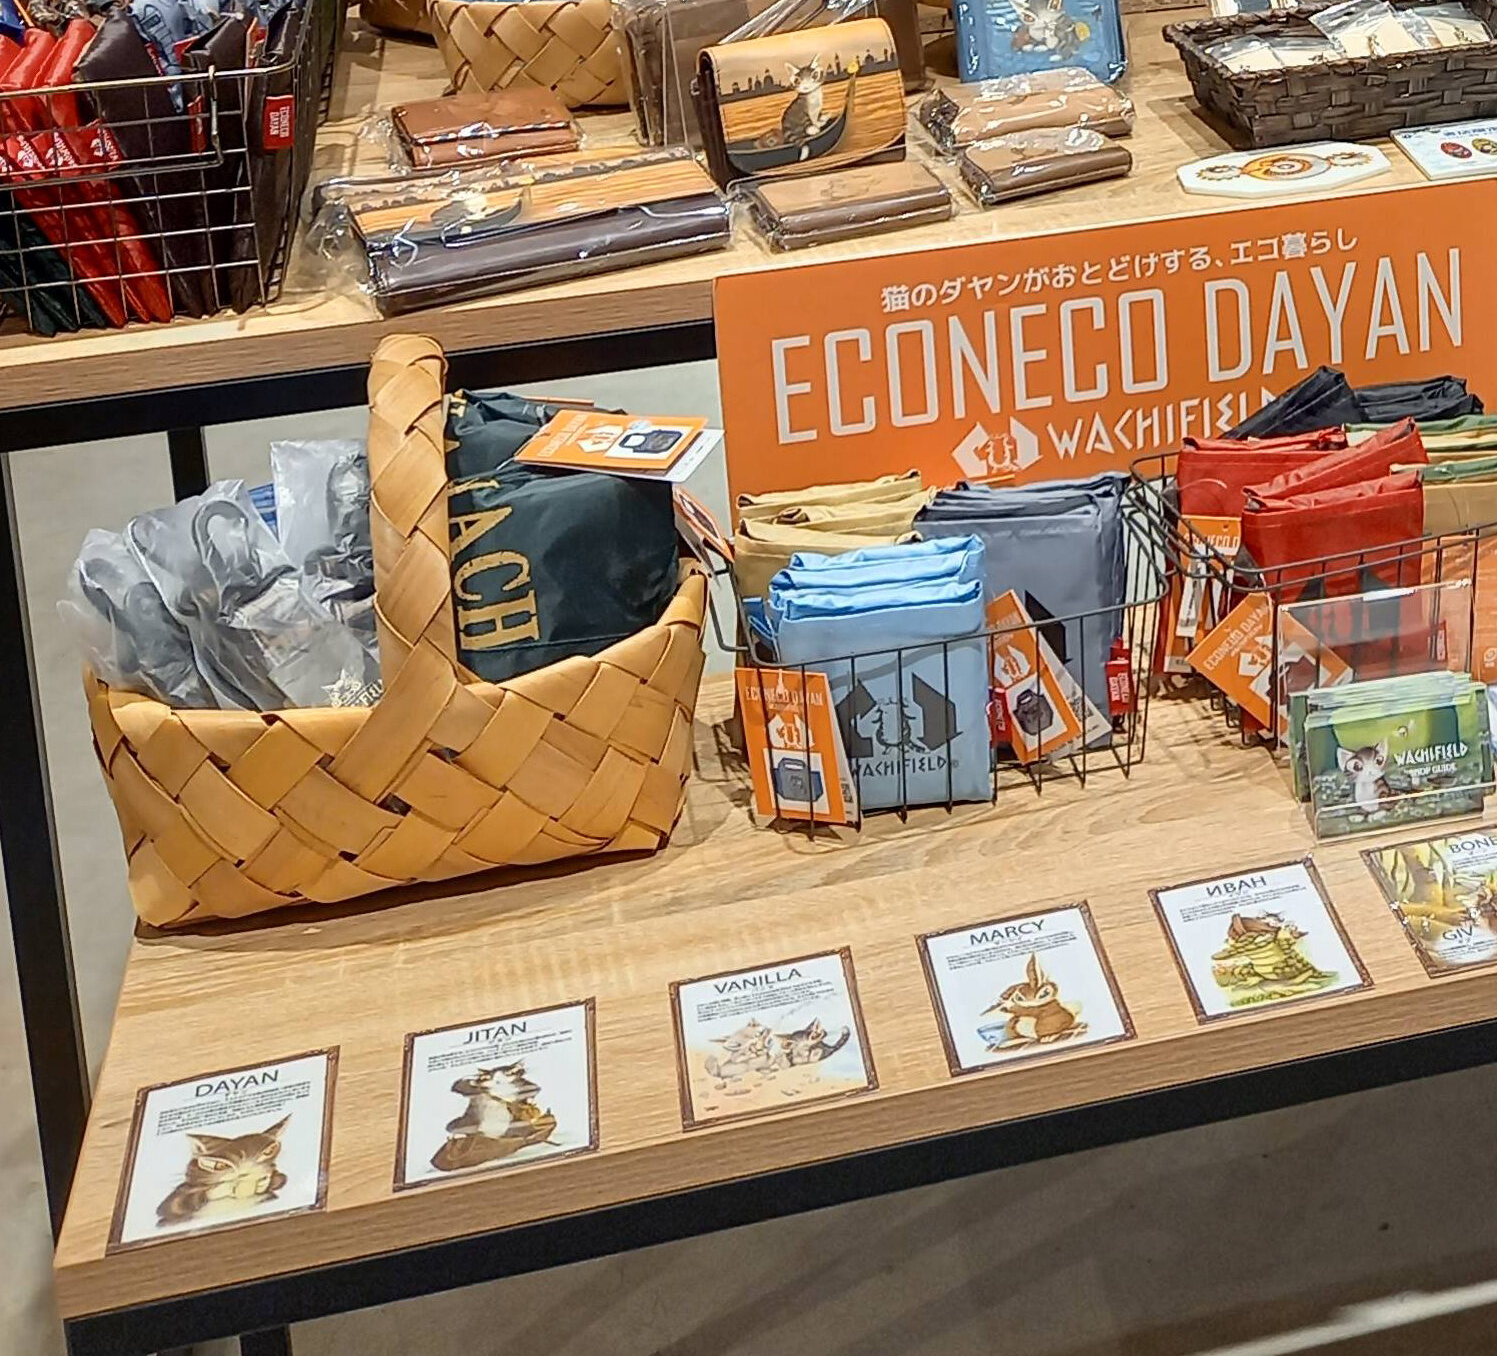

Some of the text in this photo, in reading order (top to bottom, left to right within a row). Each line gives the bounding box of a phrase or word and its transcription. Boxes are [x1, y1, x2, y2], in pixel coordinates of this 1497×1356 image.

[880, 228, 1358, 313] 猫のダヤンがおとどけする、エコ暮らし
[771, 247, 1464, 446] ECONECO DAYAN
[1393, 742, 1468, 765] WACHIFIELD
[969, 919, 1047, 946] MARCY
[1442, 924, 1475, 941] GIV
[713, 968, 802, 995] VANILLA
[463, 1021, 528, 1045] JITAN
[195, 1070, 280, 1098] DAYAN
